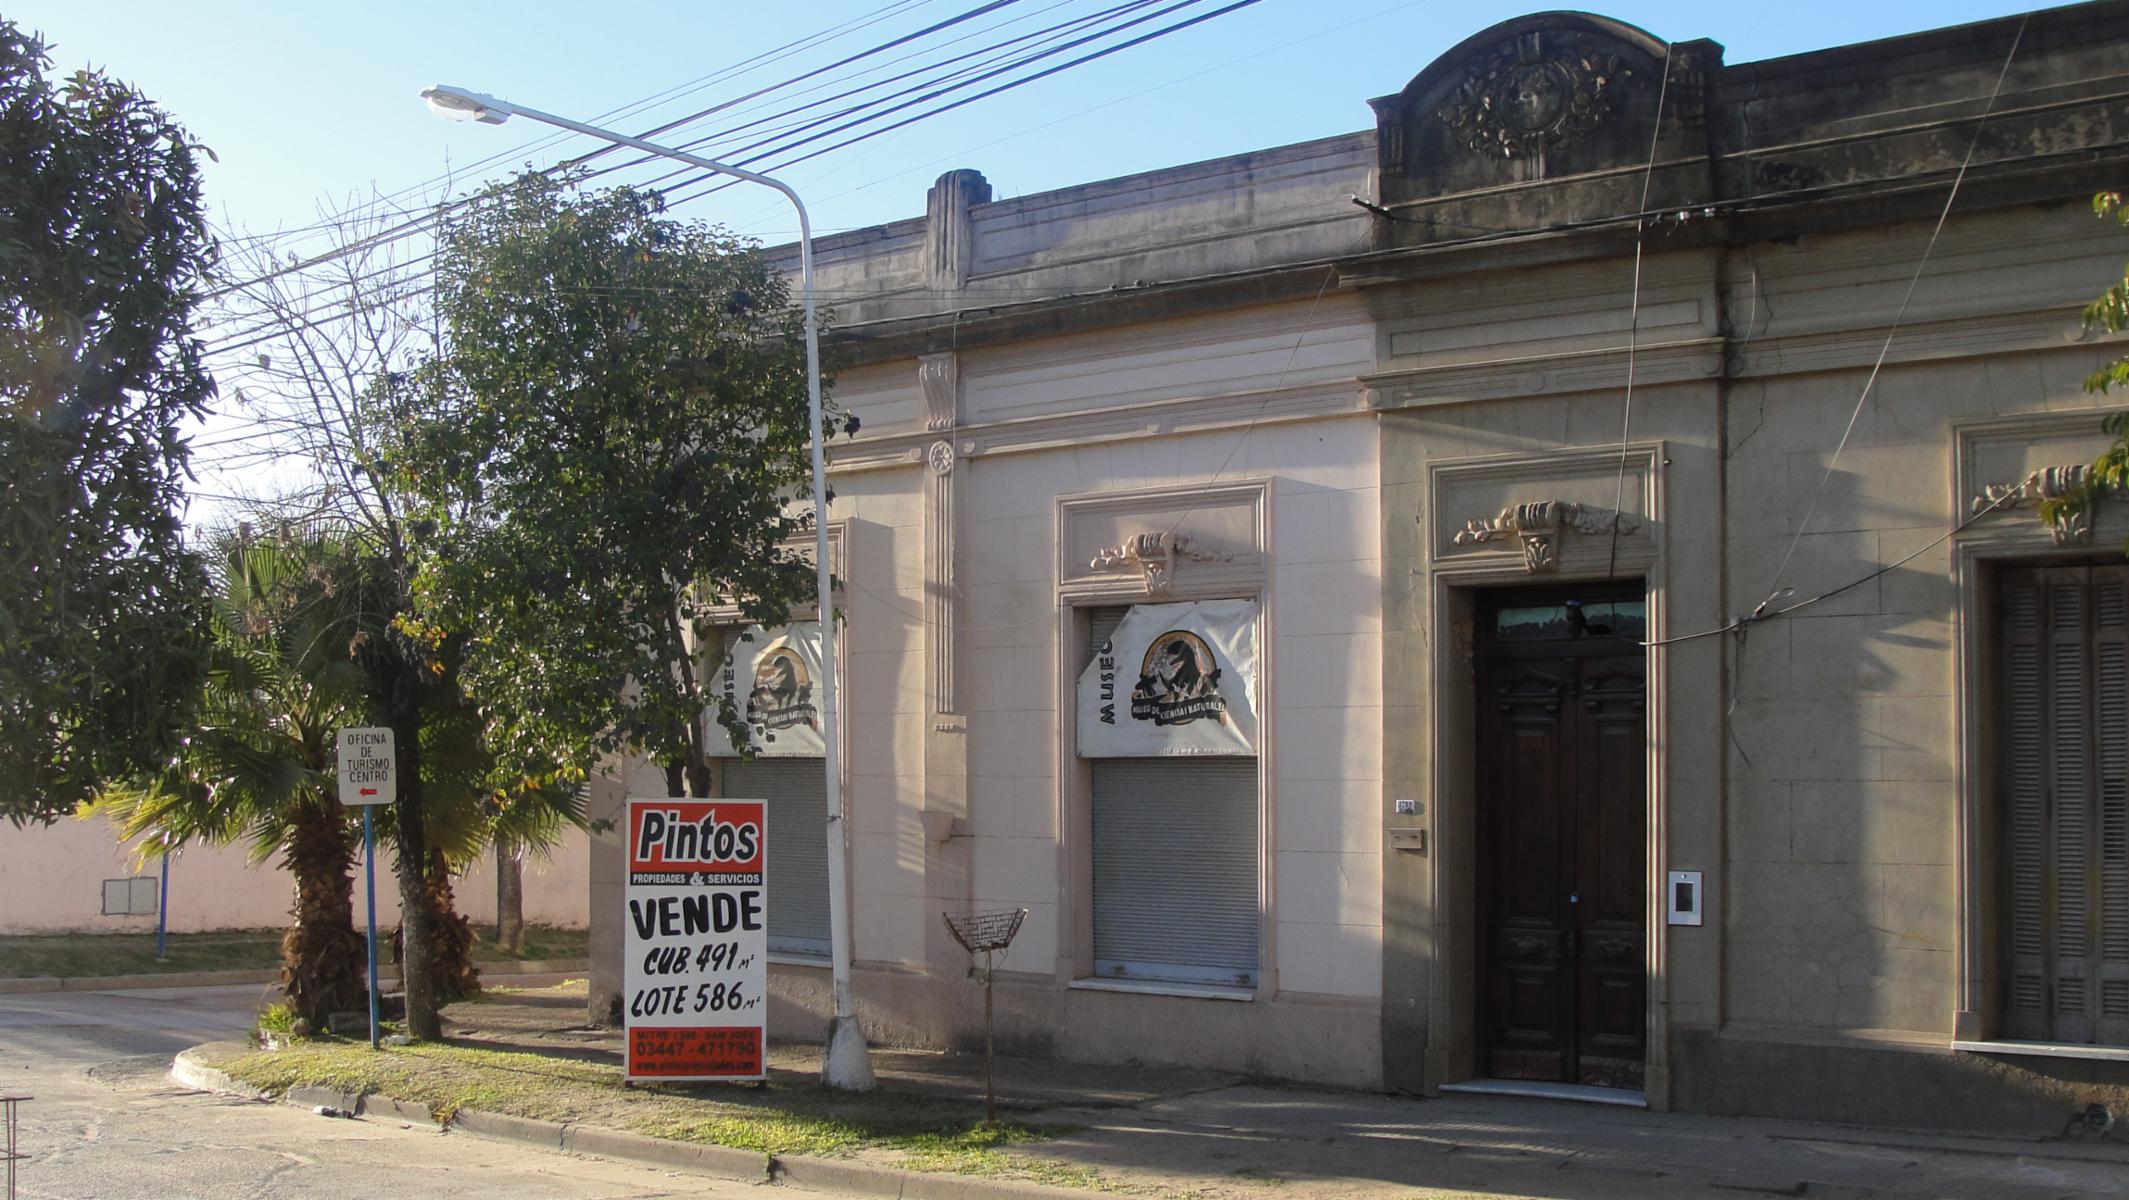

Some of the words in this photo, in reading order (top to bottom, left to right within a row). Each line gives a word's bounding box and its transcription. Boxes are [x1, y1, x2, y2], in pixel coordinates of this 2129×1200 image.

[347, 733, 387, 745] OFICINA
[361, 746, 372, 758] DE
[347, 758, 389, 771] TURISMO
[349, 770, 388, 783] CENTRO
[637, 809, 759, 862] Pintos
[633, 874, 686, 884] PROPIEDADES
[690, 872, 705, 886] &
[708, 874, 760, 884] SERVICIOS
[629, 891, 762, 940] VENDE
[644, 946, 691, 976] CUB.
[696, 942, 739, 972] 491
[631, 985, 689, 1018] LOTE
[694, 981, 743, 1012] 586
[637, 1041, 685, 1056] 03447
